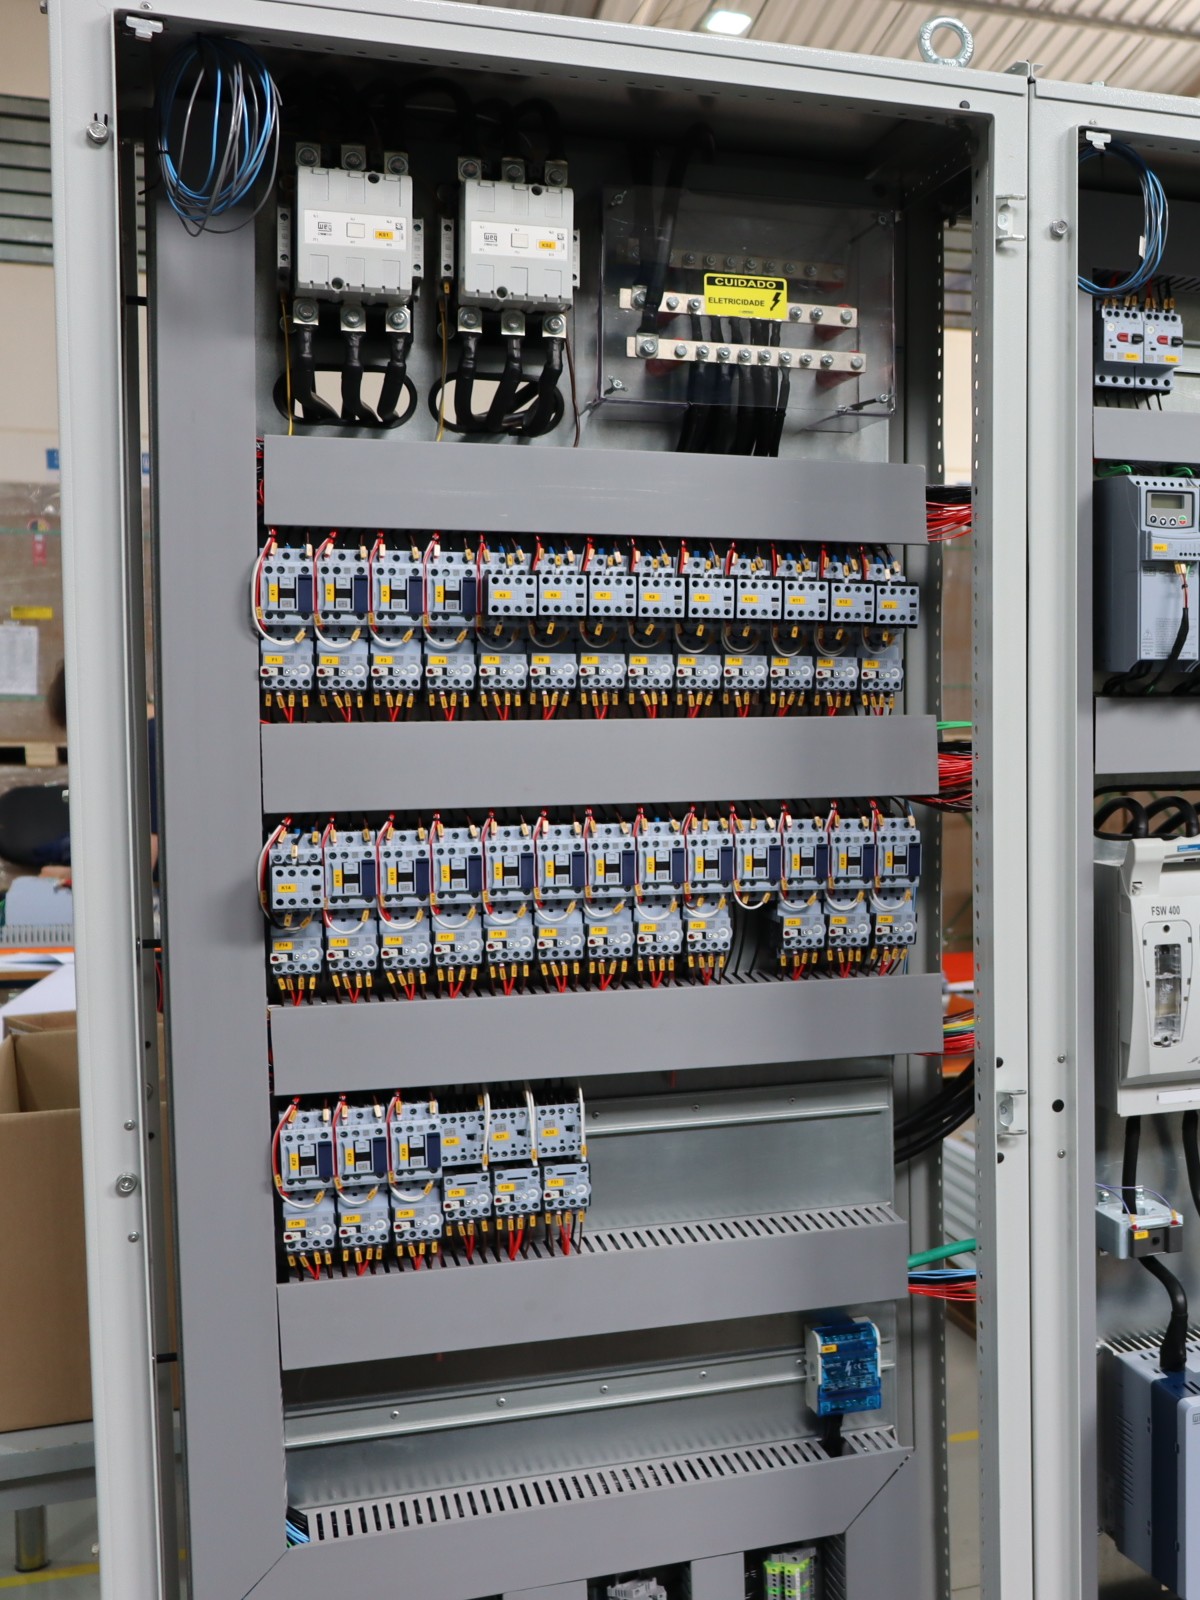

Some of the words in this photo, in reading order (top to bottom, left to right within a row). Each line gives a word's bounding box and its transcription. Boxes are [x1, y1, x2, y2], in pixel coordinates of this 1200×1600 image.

[715, 278, 776, 289] CUIDADO
[708, 297, 765, 307] ELETRICIDADE
[1151, 906, 1167, 916] FSW
[1169, 905, 1180, 915] 400
